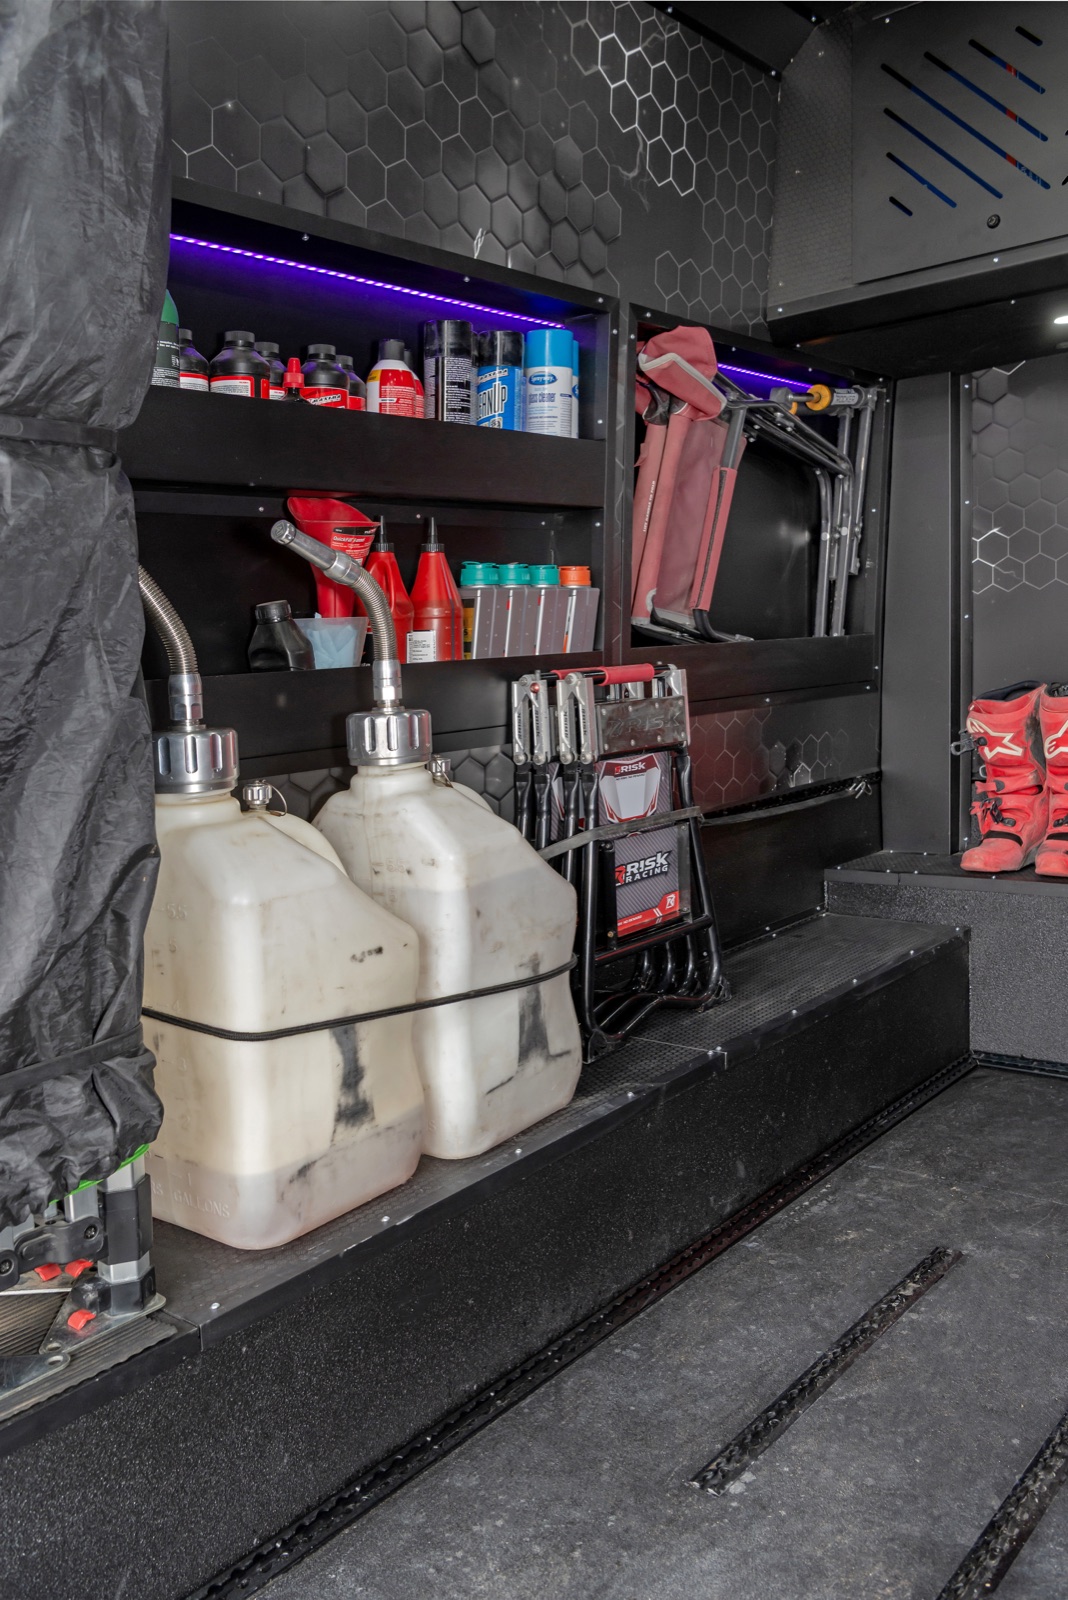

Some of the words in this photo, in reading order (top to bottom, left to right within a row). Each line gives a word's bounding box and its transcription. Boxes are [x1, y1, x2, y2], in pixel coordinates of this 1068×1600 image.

[478, 382, 507, 420] EANUP
[539, 392, 556, 402] cleaner
[620, 762, 646, 773] RISK
[626, 852, 669, 876] RISK
[625, 865, 668, 884] RACING
[167, 903, 189, 920] 5.5
[173, 1190, 230, 1217] GALLONS
